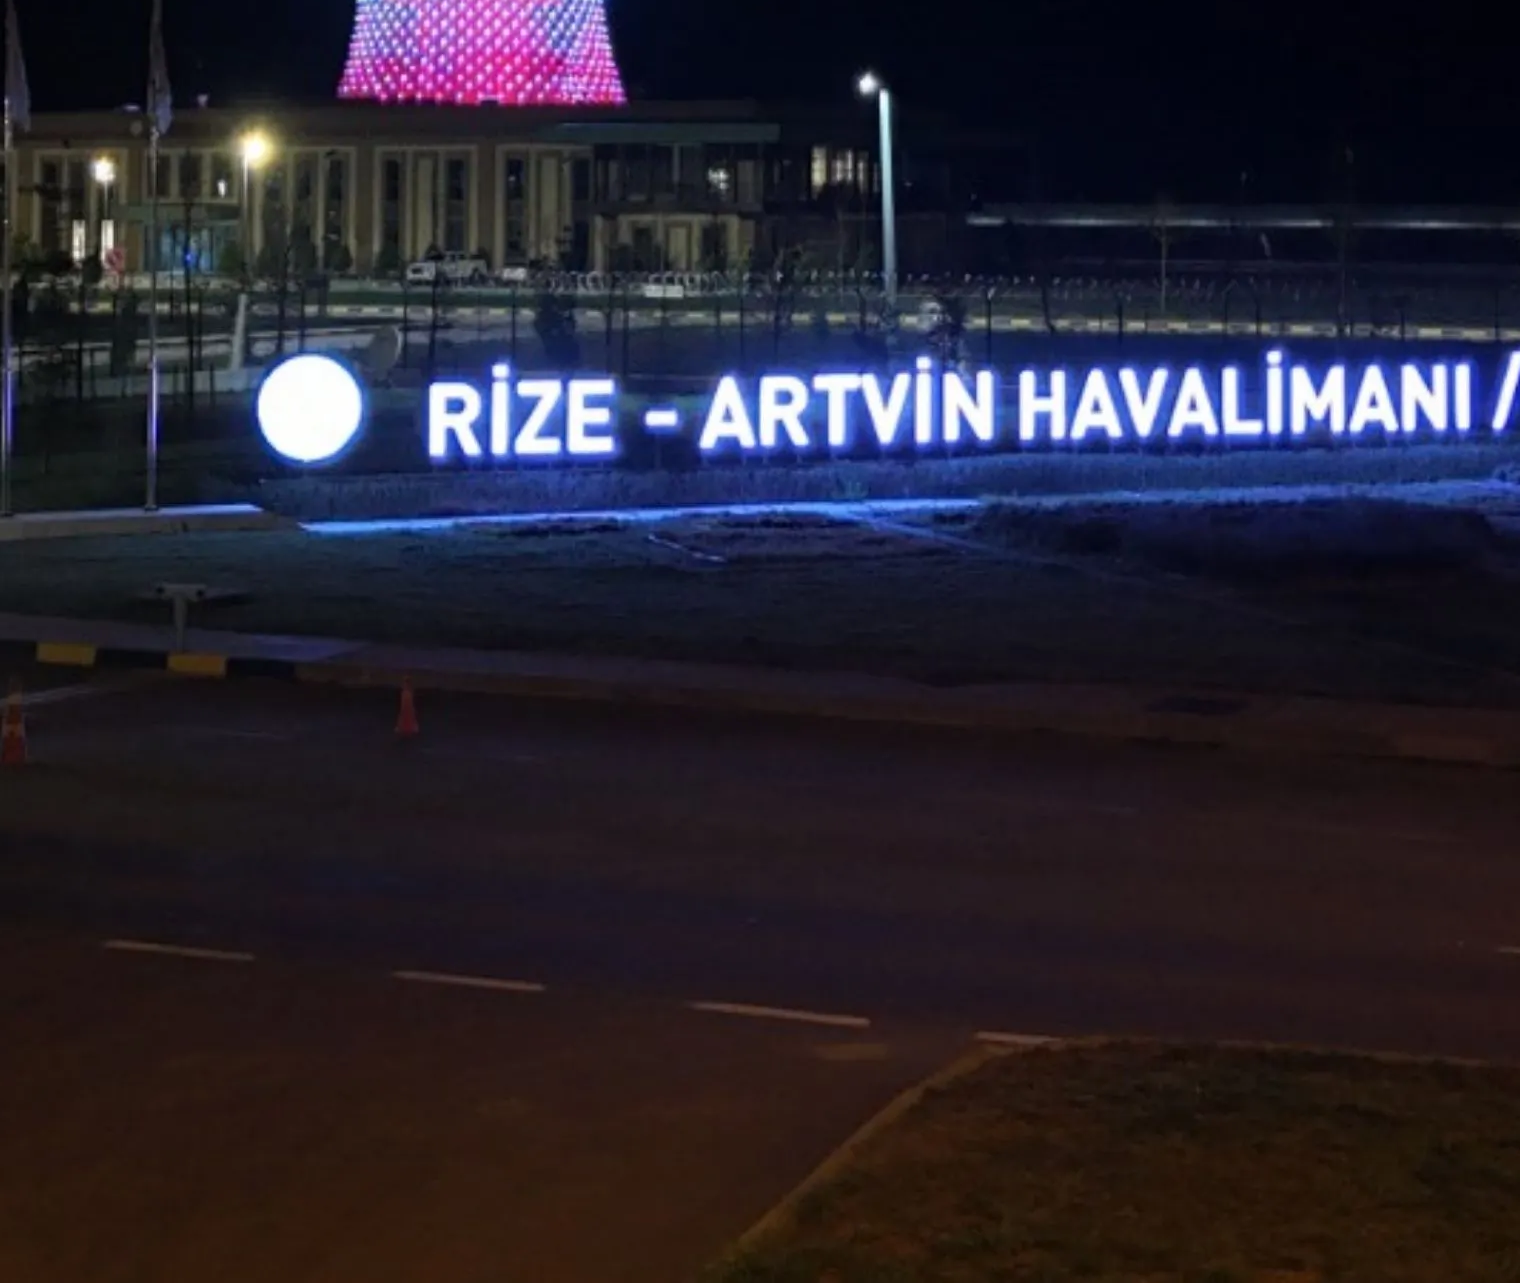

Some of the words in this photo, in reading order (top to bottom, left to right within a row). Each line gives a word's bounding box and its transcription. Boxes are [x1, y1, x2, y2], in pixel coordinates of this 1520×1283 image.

[426, 360, 616, 459] RİZE
[698, 354, 995, 451] ARTVİN
[1017, 348, 1471, 442] HAVALİMANI
